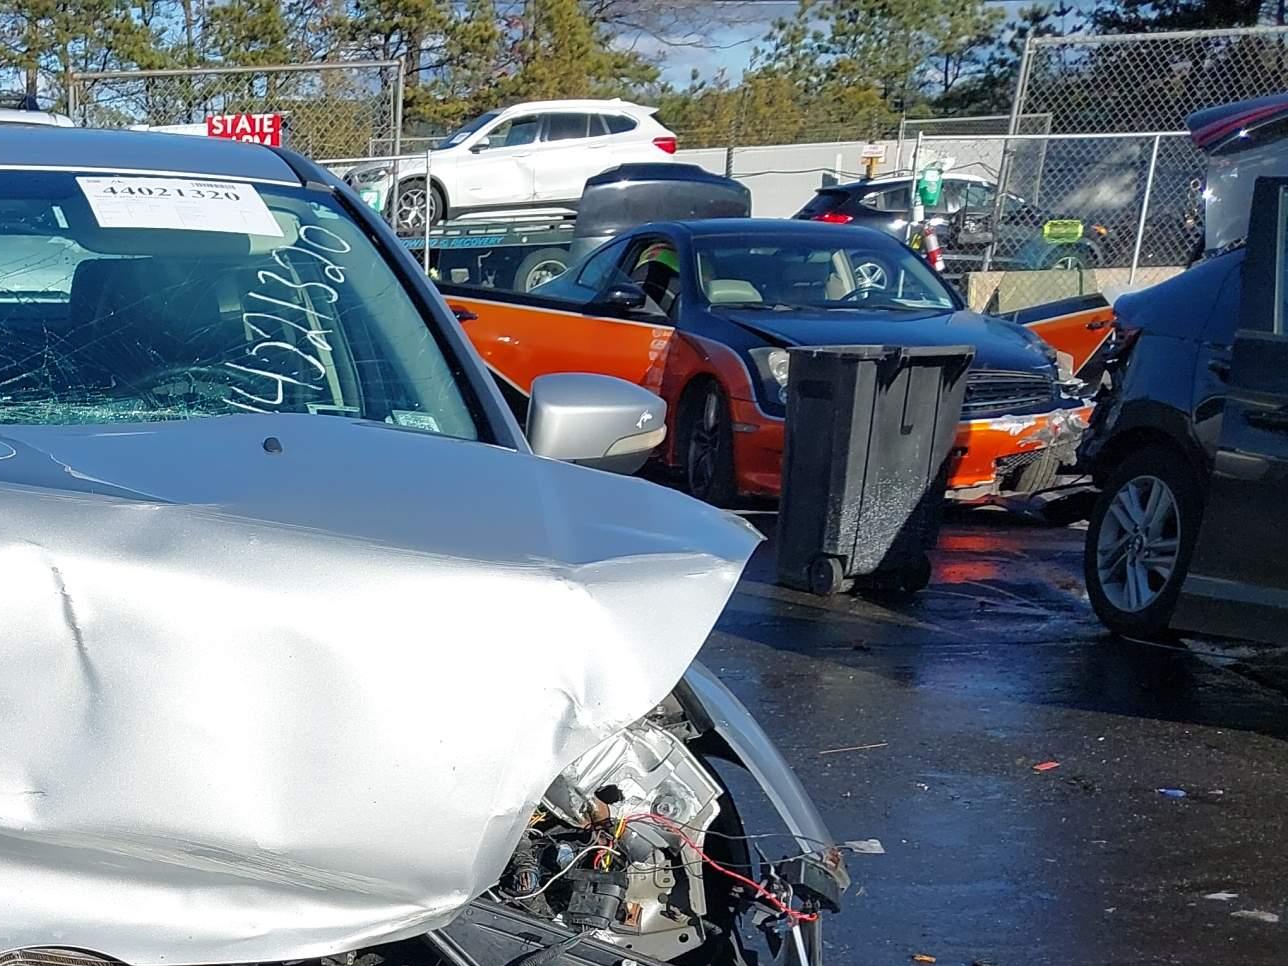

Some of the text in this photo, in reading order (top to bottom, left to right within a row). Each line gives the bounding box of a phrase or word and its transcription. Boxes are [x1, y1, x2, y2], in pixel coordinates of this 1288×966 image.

[211, 114, 274, 134] STATE
[102, 186, 241, 202] 44021320
[450, 236, 505, 248] RECOVERY
